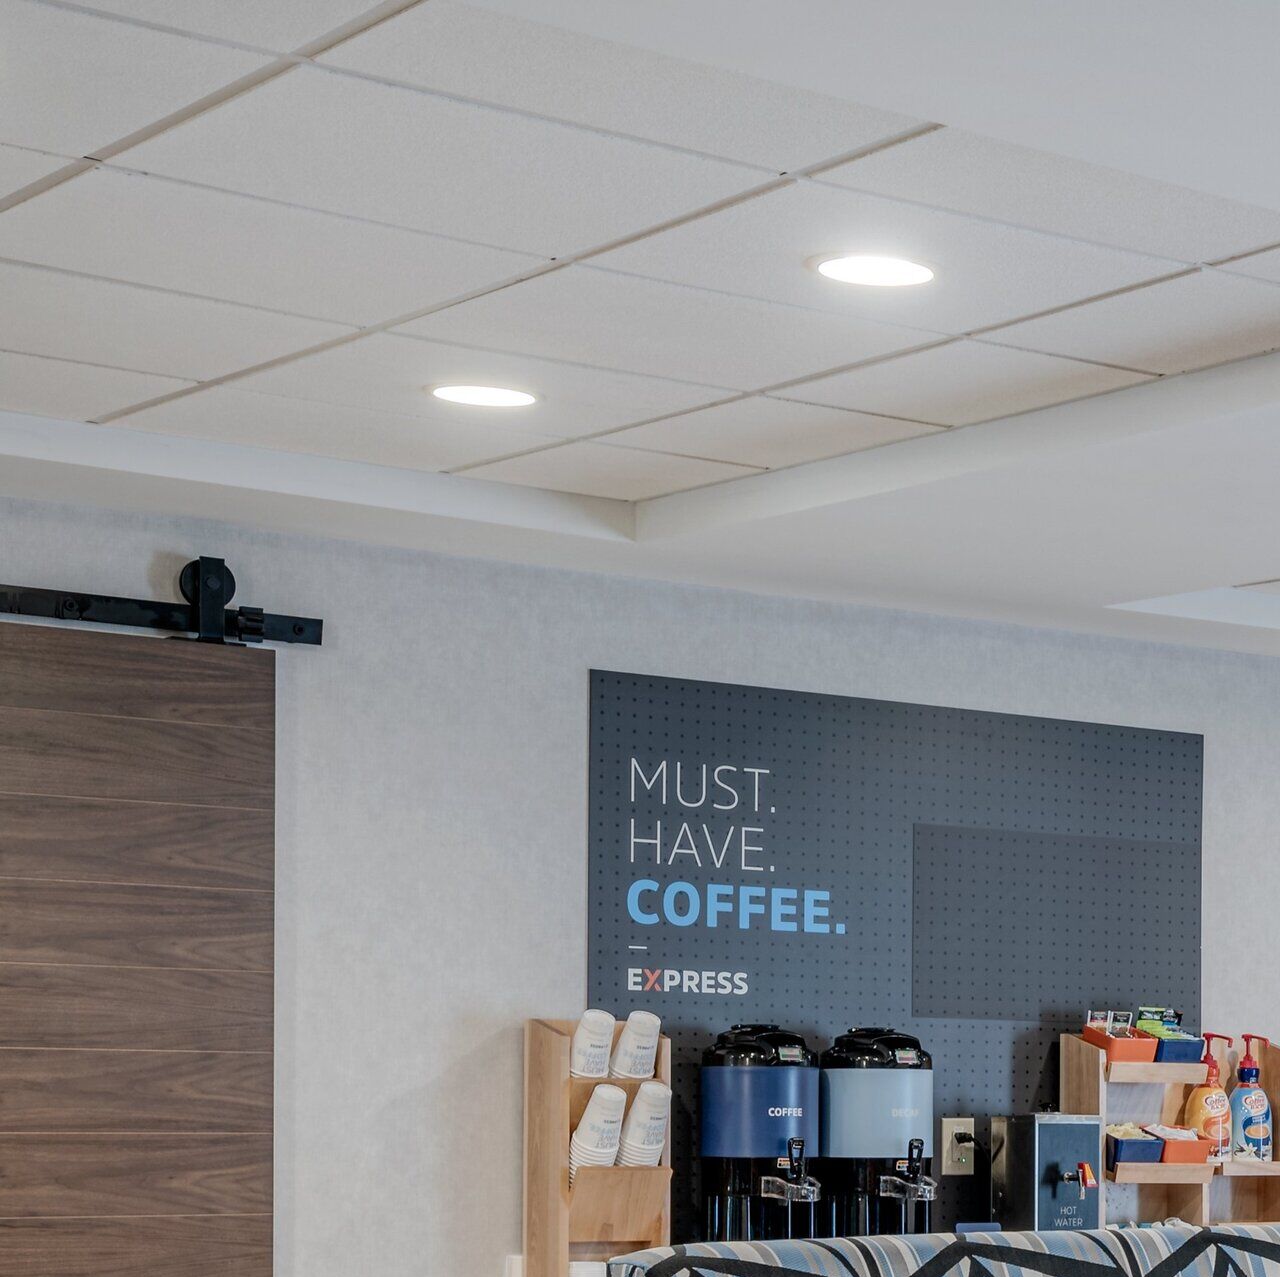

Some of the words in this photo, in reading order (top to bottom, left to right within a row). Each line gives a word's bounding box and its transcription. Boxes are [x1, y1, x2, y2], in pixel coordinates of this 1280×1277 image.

[630, 757, 776, 813] MUST.
[630, 818, 775, 872] HAVE.
[626, 878, 846, 935] COFFEE.
[627, 967, 749, 995] EXPRESS
[768, 1107, 803, 1117] COFFEE
[1054, 1218, 1083, 1227] WATER
[1060, 1206, 1077, 1215] HOT
